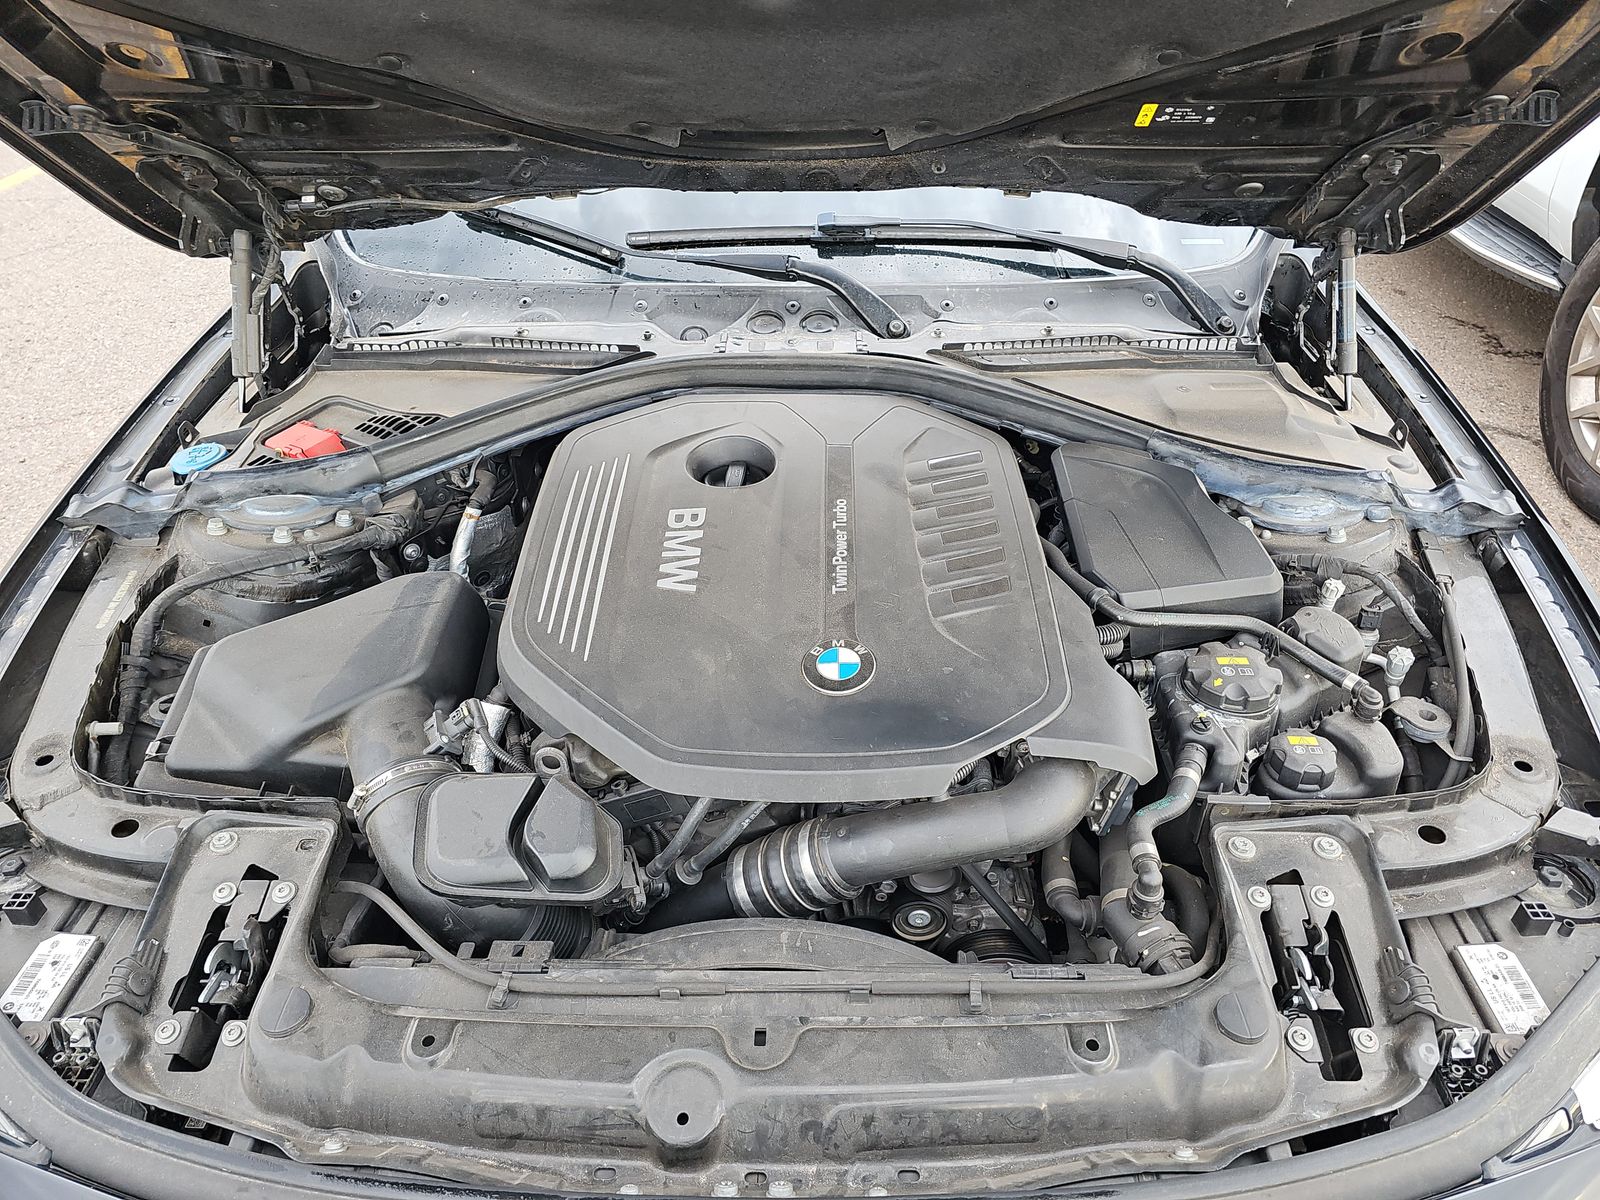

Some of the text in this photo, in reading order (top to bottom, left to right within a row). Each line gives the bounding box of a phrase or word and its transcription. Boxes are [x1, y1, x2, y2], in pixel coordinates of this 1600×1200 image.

[656, 507, 707, 592] BMW
[831, 498, 848, 595] TwinPower Turbo
[810, 639, 868, 656] BMW
